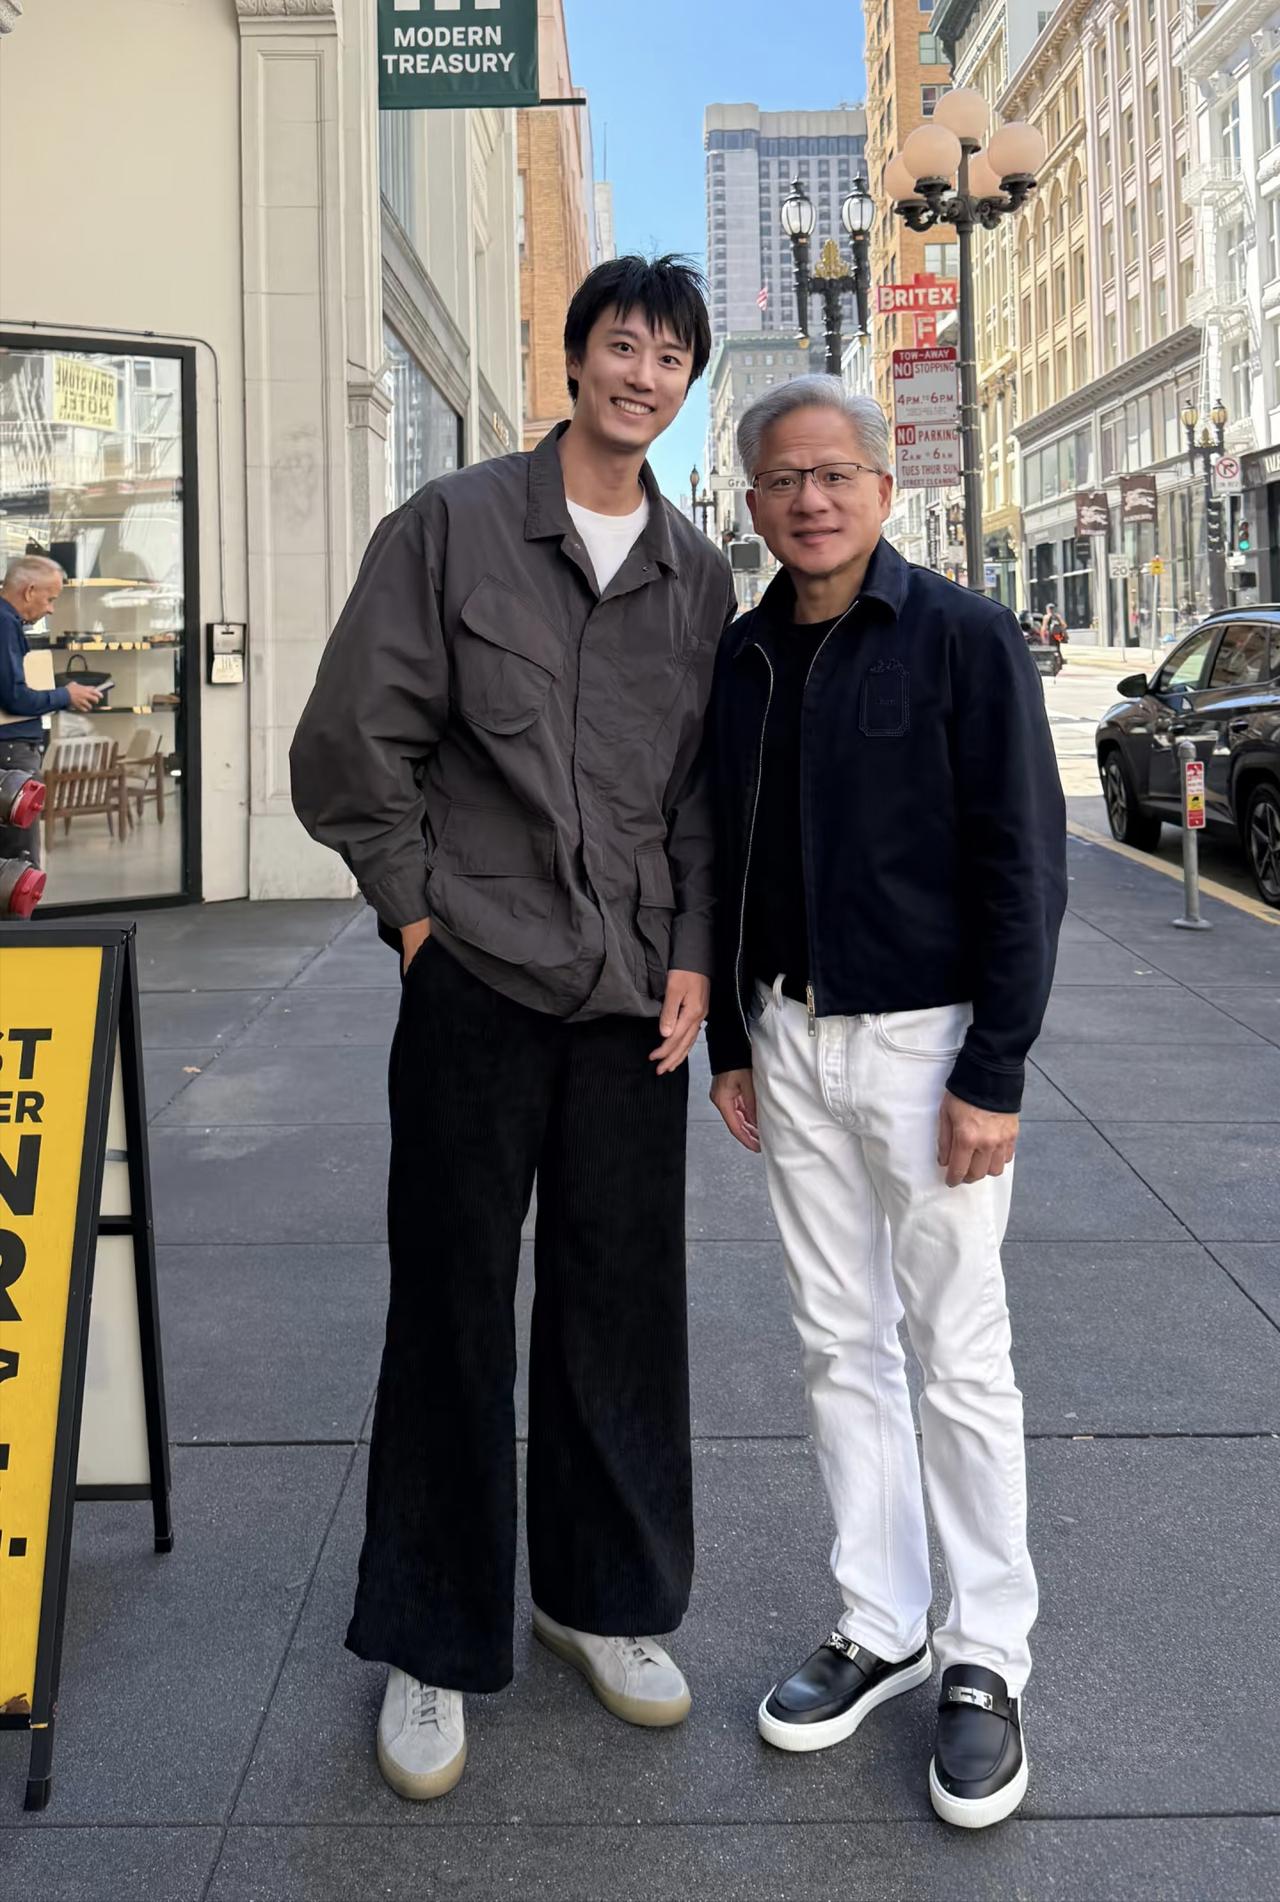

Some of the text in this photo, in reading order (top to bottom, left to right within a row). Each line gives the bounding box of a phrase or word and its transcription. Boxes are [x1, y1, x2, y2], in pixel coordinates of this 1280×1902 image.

[394, 26, 502, 47] MODERN
[382, 52, 516, 74] TREASURY
[880, 287, 954, 310] BRITEX
[899, 349, 950, 361] TOW-AWAY
[894, 362, 954, 377] NO STOPPING
[897, 427, 958, 444] NO PARKING
[901, 465, 920, 476] TUES
[1112, 566, 1128, 576] 20
